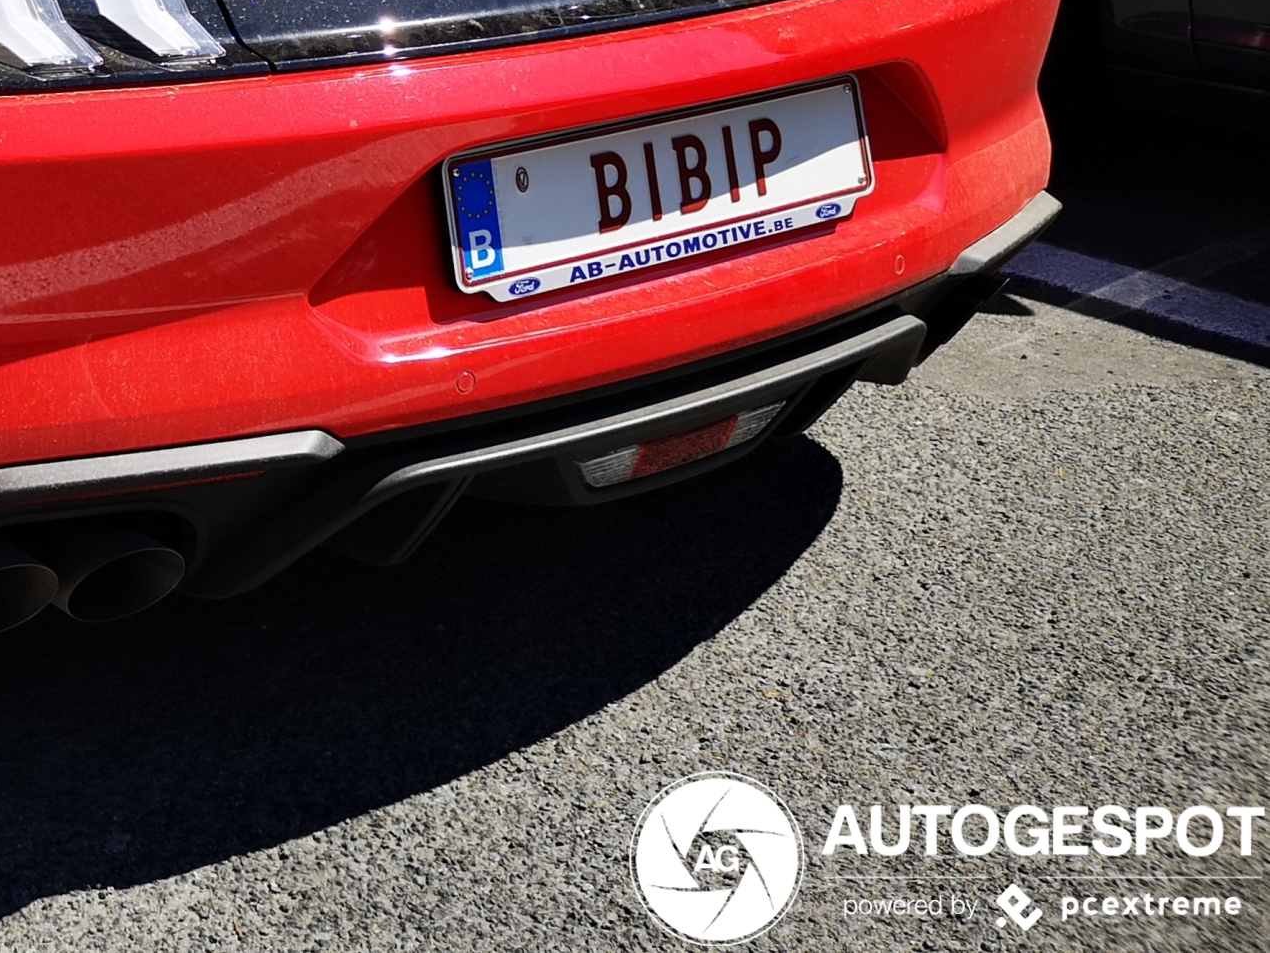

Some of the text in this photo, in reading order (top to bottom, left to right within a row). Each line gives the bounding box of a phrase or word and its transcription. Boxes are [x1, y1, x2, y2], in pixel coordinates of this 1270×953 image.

[588, 117, 783, 234] BIBIP
[818, 204, 838, 218] Ford
[468, 228, 497, 271] B
[568, 217, 794, 283] AB-AUTOMOTIVE.BE
[512, 279, 537, 295] Ford
